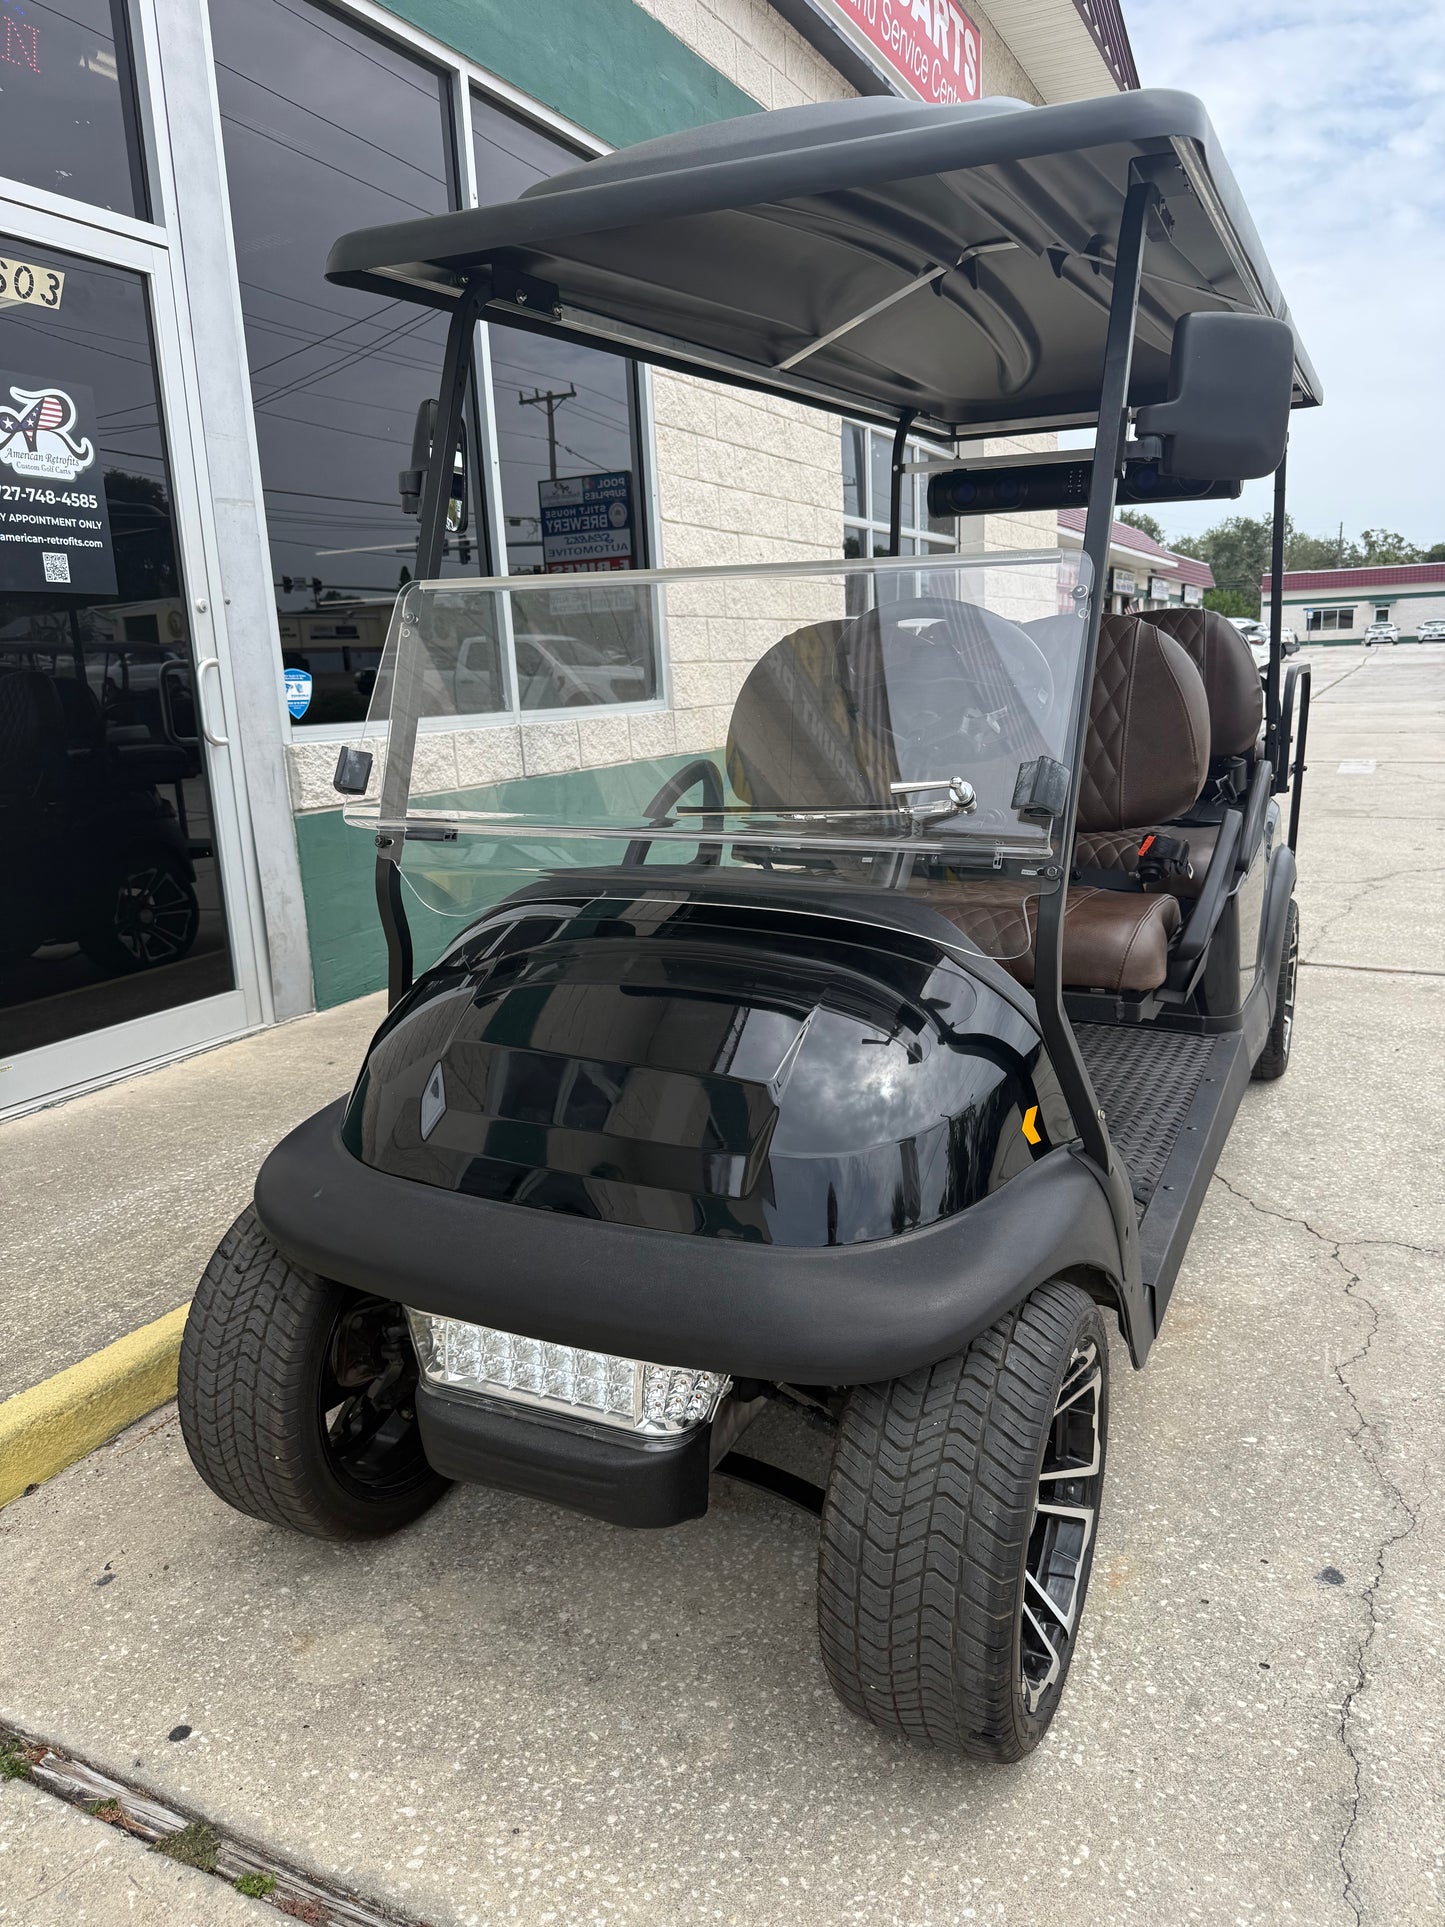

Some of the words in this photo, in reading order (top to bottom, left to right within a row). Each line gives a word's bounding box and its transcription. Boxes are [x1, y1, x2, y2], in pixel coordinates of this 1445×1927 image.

[881, 0, 928, 84] Service
[932, 59, 962, 104] Cent
[900, 0, 978, 96] ARTS
[5, 448, 44, 461] American
[45, 453, 80, 468] Retrofits
[16, 461, 40, 471] Custom
[41, 464, 54, 473] Golf
[55, 466, 71, 475] Carts
[0, 485, 98, 509] 27-748-4585
[0, 512, 7, 522] Y
[9, 513, 77, 528] APPOINTMENT
[78, 519, 102, 530] ONLY
[0, 533, 103, 548] american-retrofits.com
